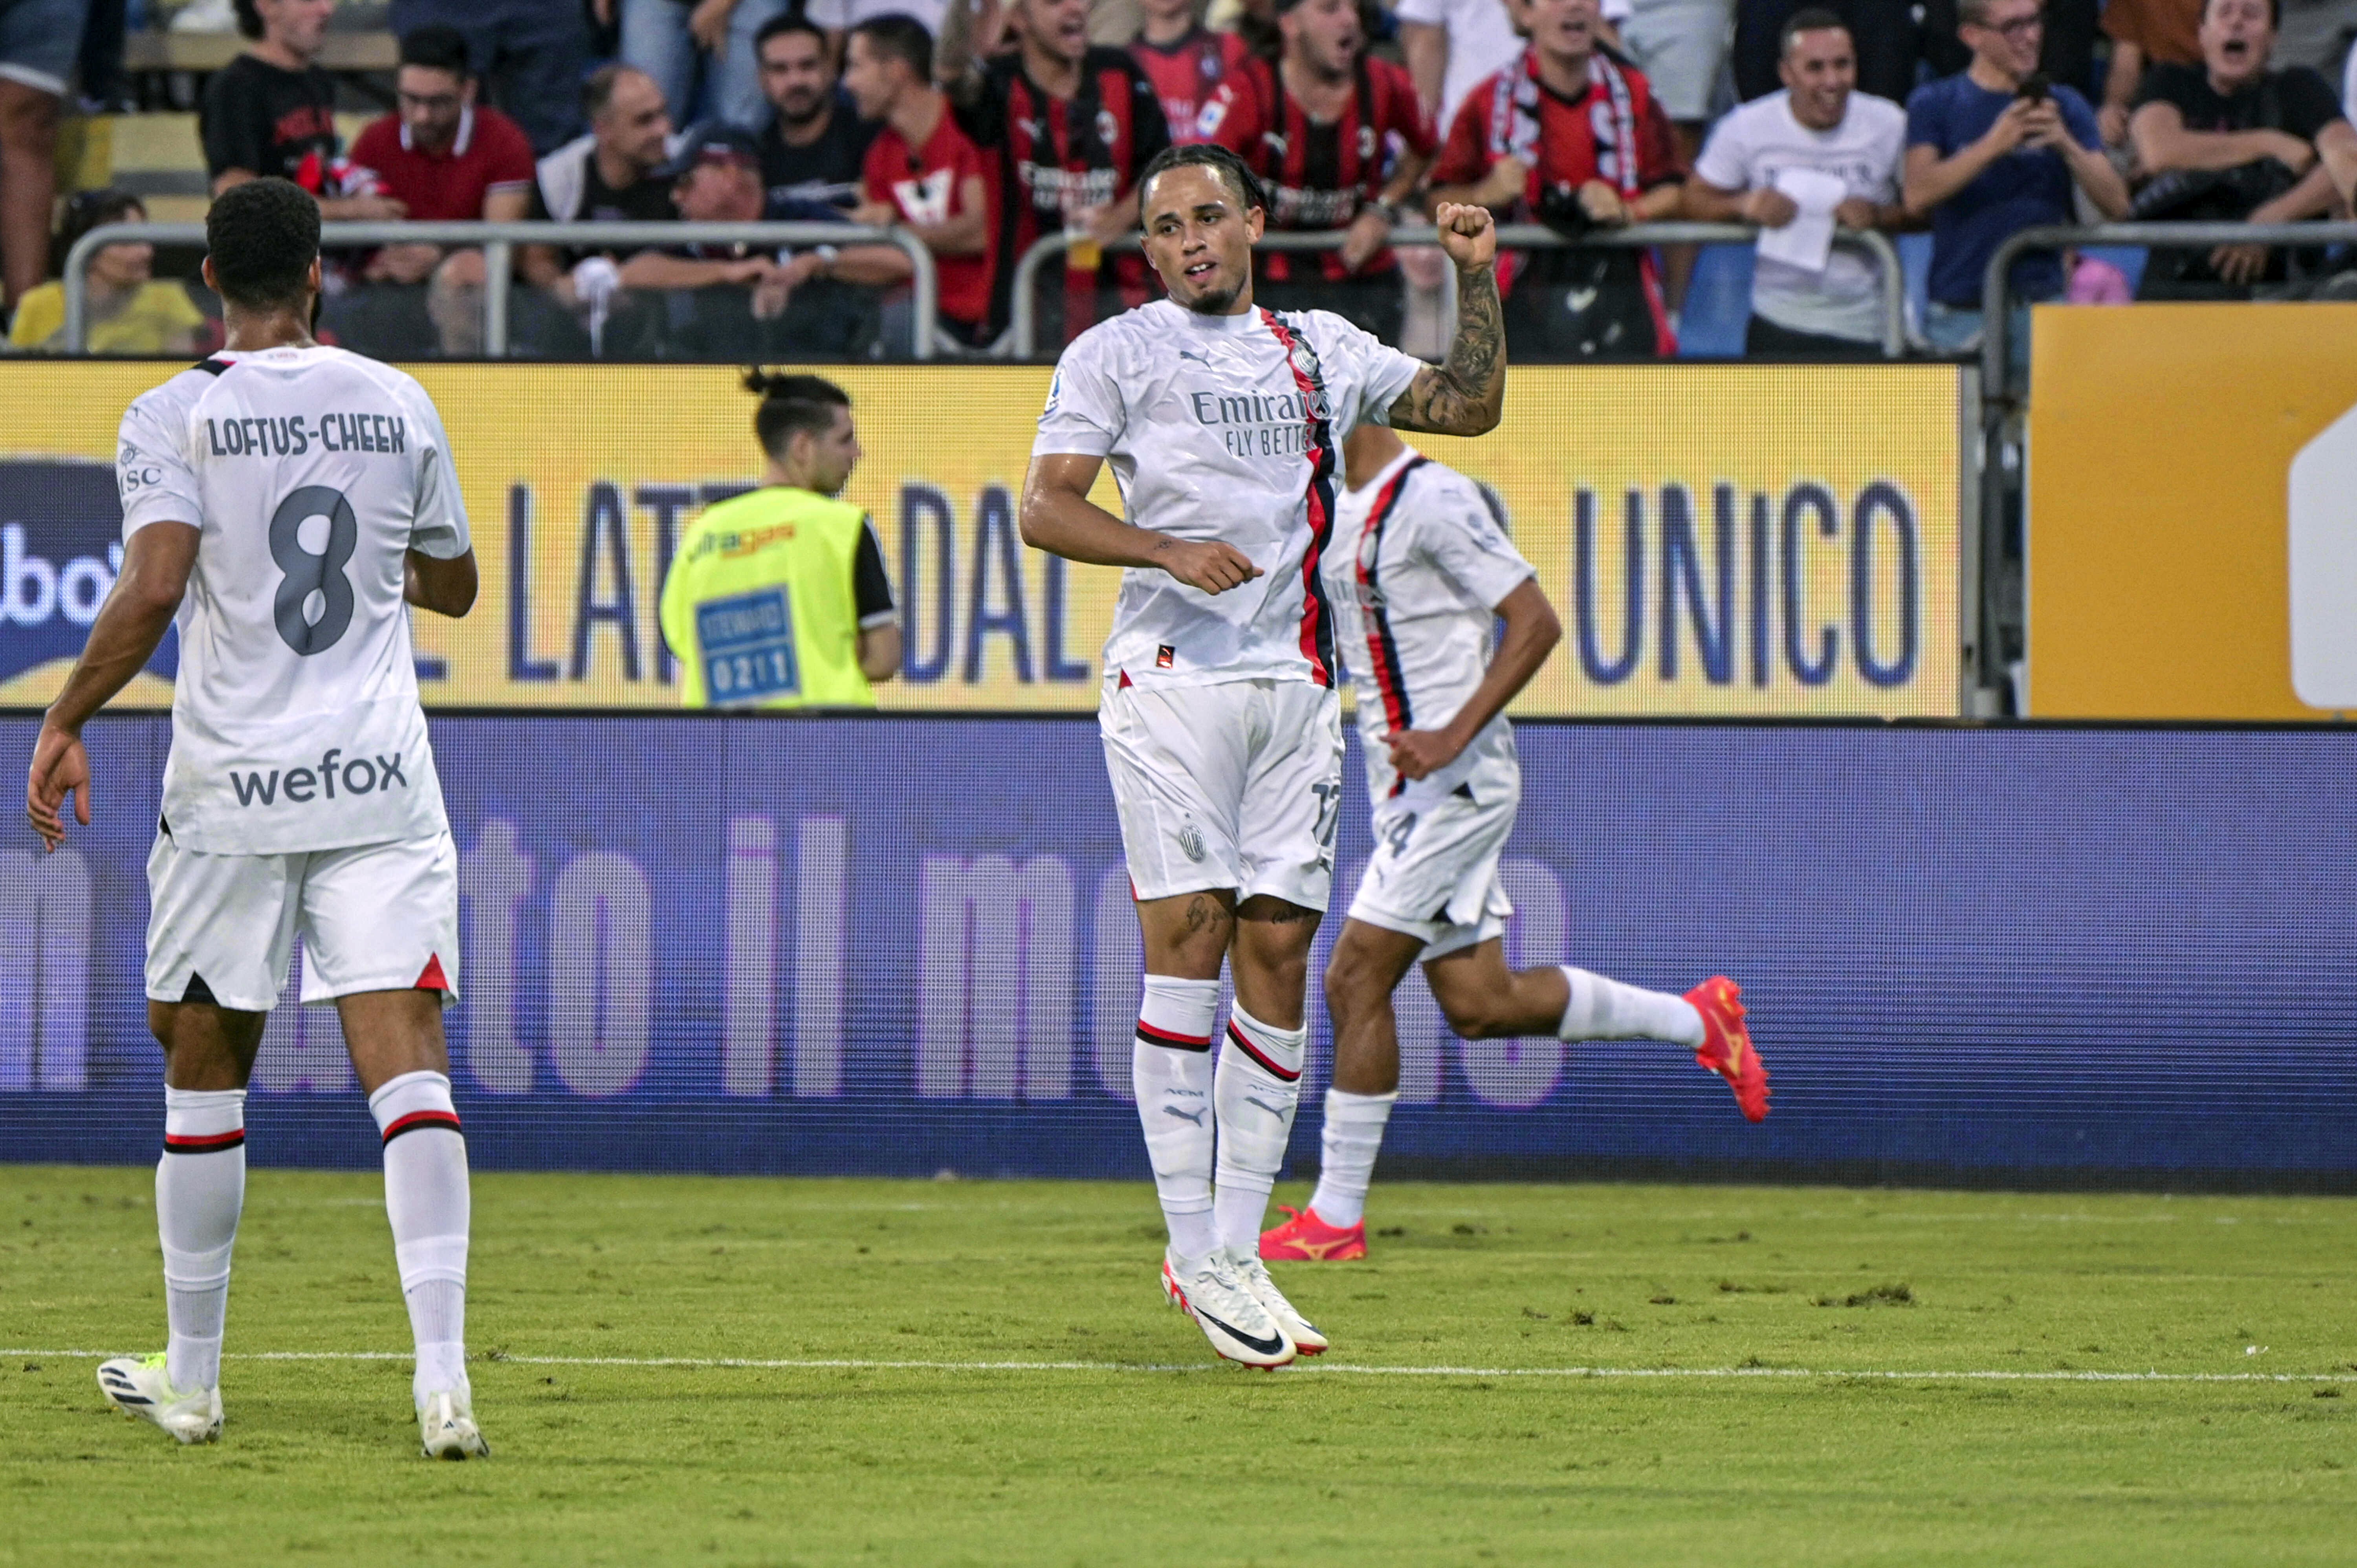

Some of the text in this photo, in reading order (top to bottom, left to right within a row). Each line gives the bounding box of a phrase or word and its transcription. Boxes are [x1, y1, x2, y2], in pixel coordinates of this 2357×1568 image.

[1190, 389, 1332, 425] Emirates
[207, 414, 405, 457] LOFTUS-CHEEK
[1226, 424, 1318, 457] FLY BETTER
[119, 467, 161, 496] SC
[269, 485, 357, 656] 8
[901, 484, 1091, 683] DAL
[1575, 481, 1922, 690] UNICO
[229, 748, 407, 807] wefox
[724, 817, 845, 1096] il
